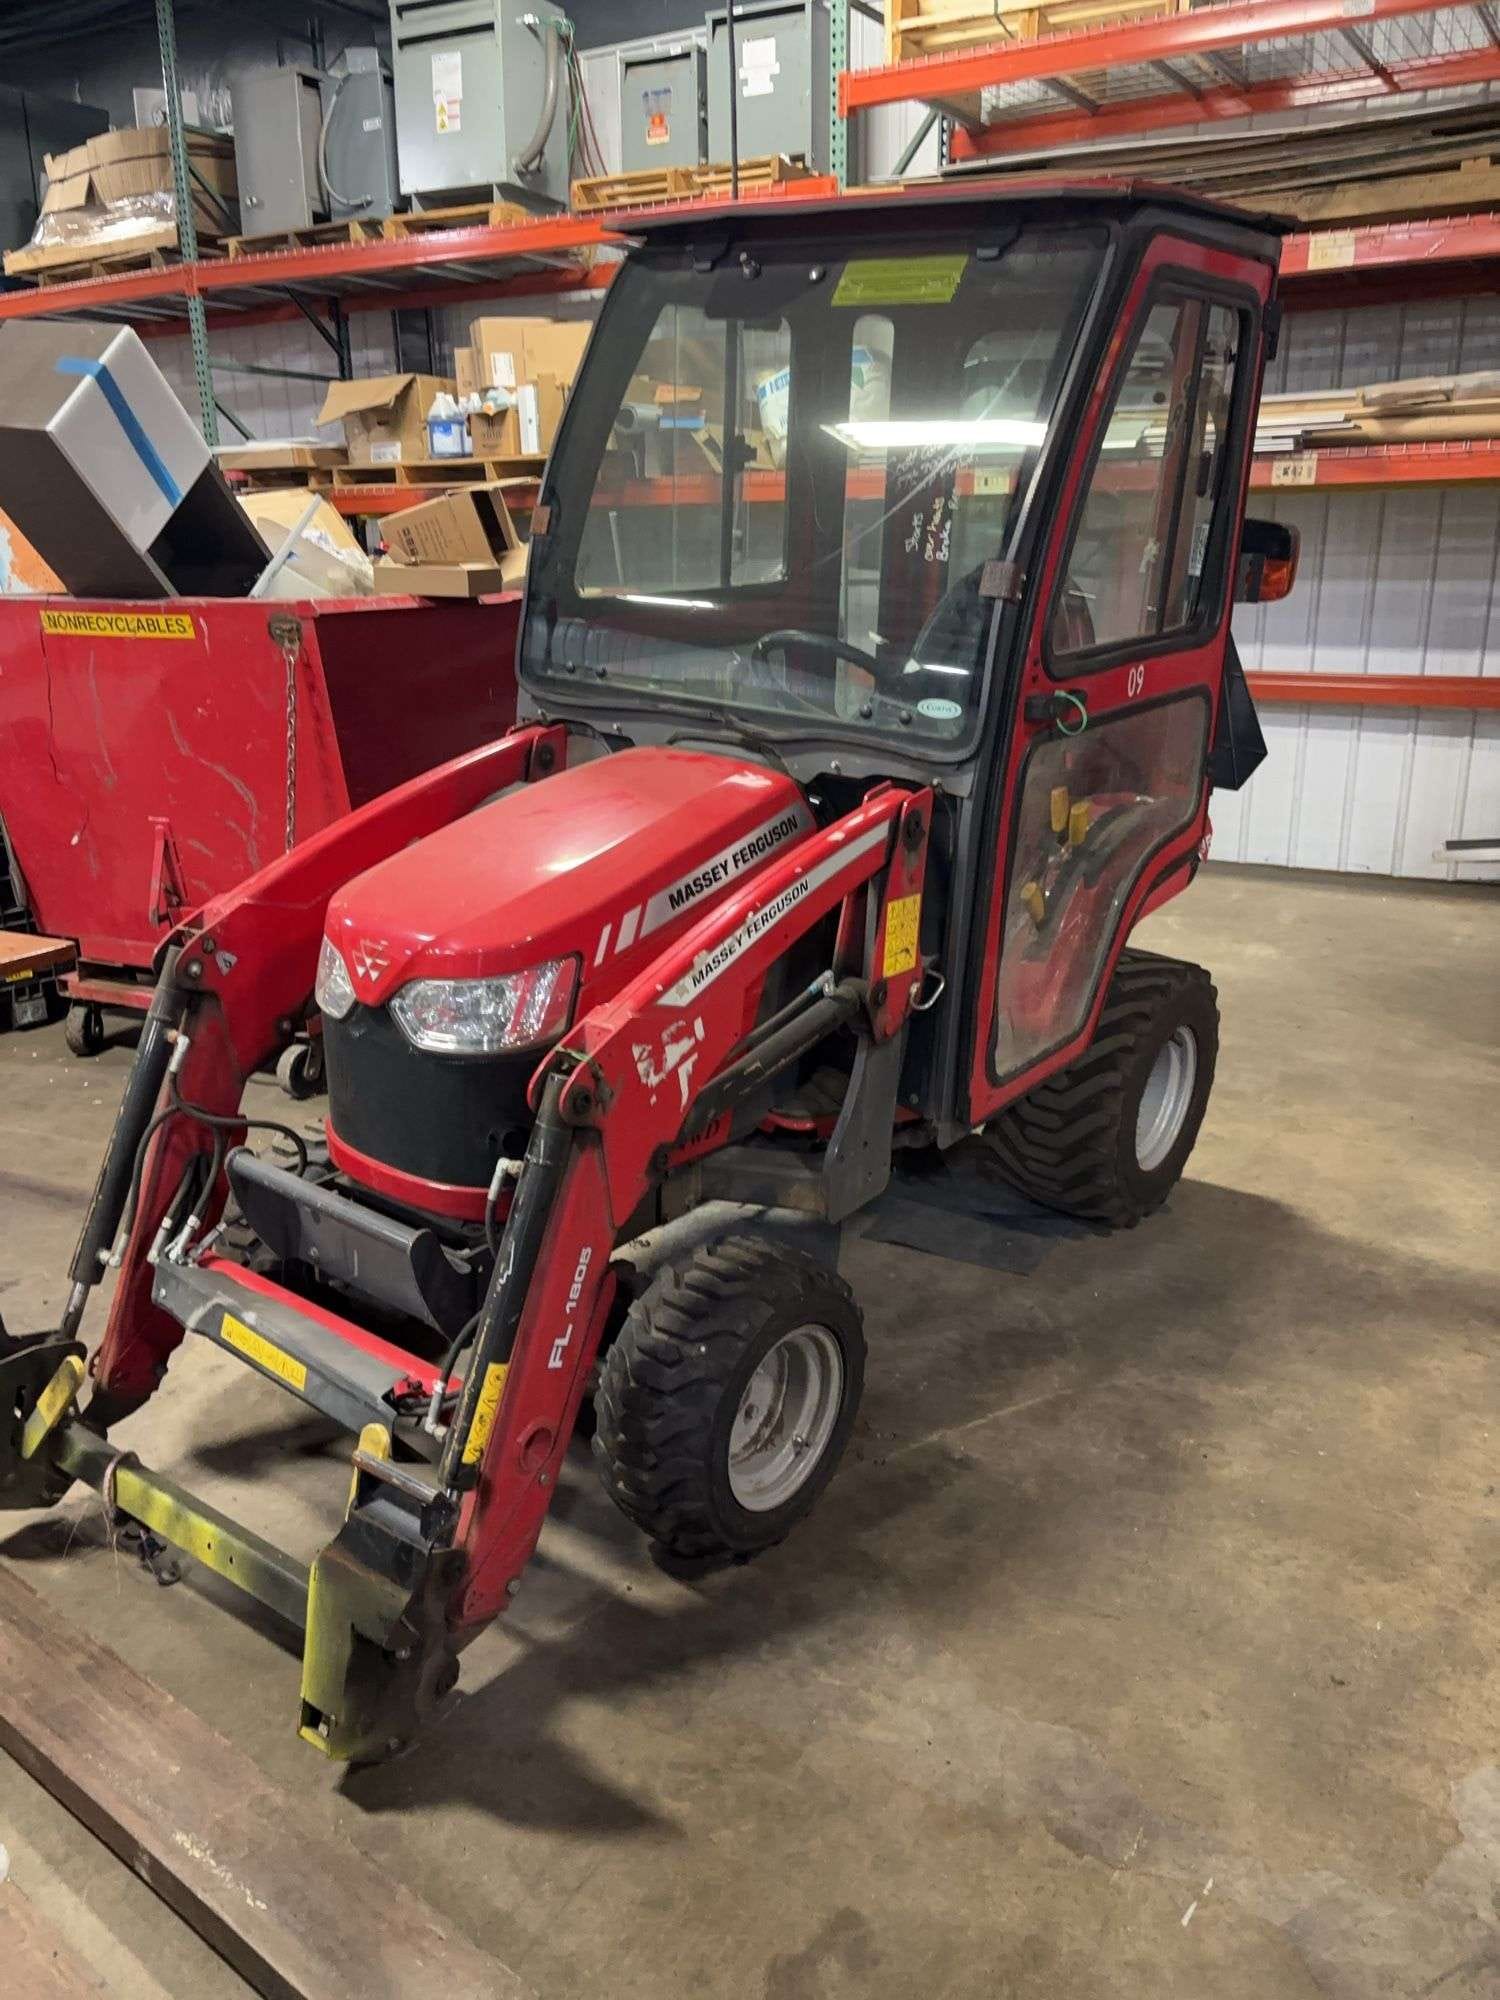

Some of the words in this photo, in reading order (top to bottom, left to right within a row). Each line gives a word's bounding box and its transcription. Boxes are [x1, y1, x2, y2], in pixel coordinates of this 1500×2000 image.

[45, 613, 188, 634] NONRECYCLABLES
[1127, 663, 1145, 698] 09
[667, 857, 729, 911] MASSEY
[731, 814, 799, 870] FERGUSON
[690, 934, 743, 988] MASSEY
[746, 879, 809, 939] FERGUSON
[547, 1322, 574, 1370] FL
